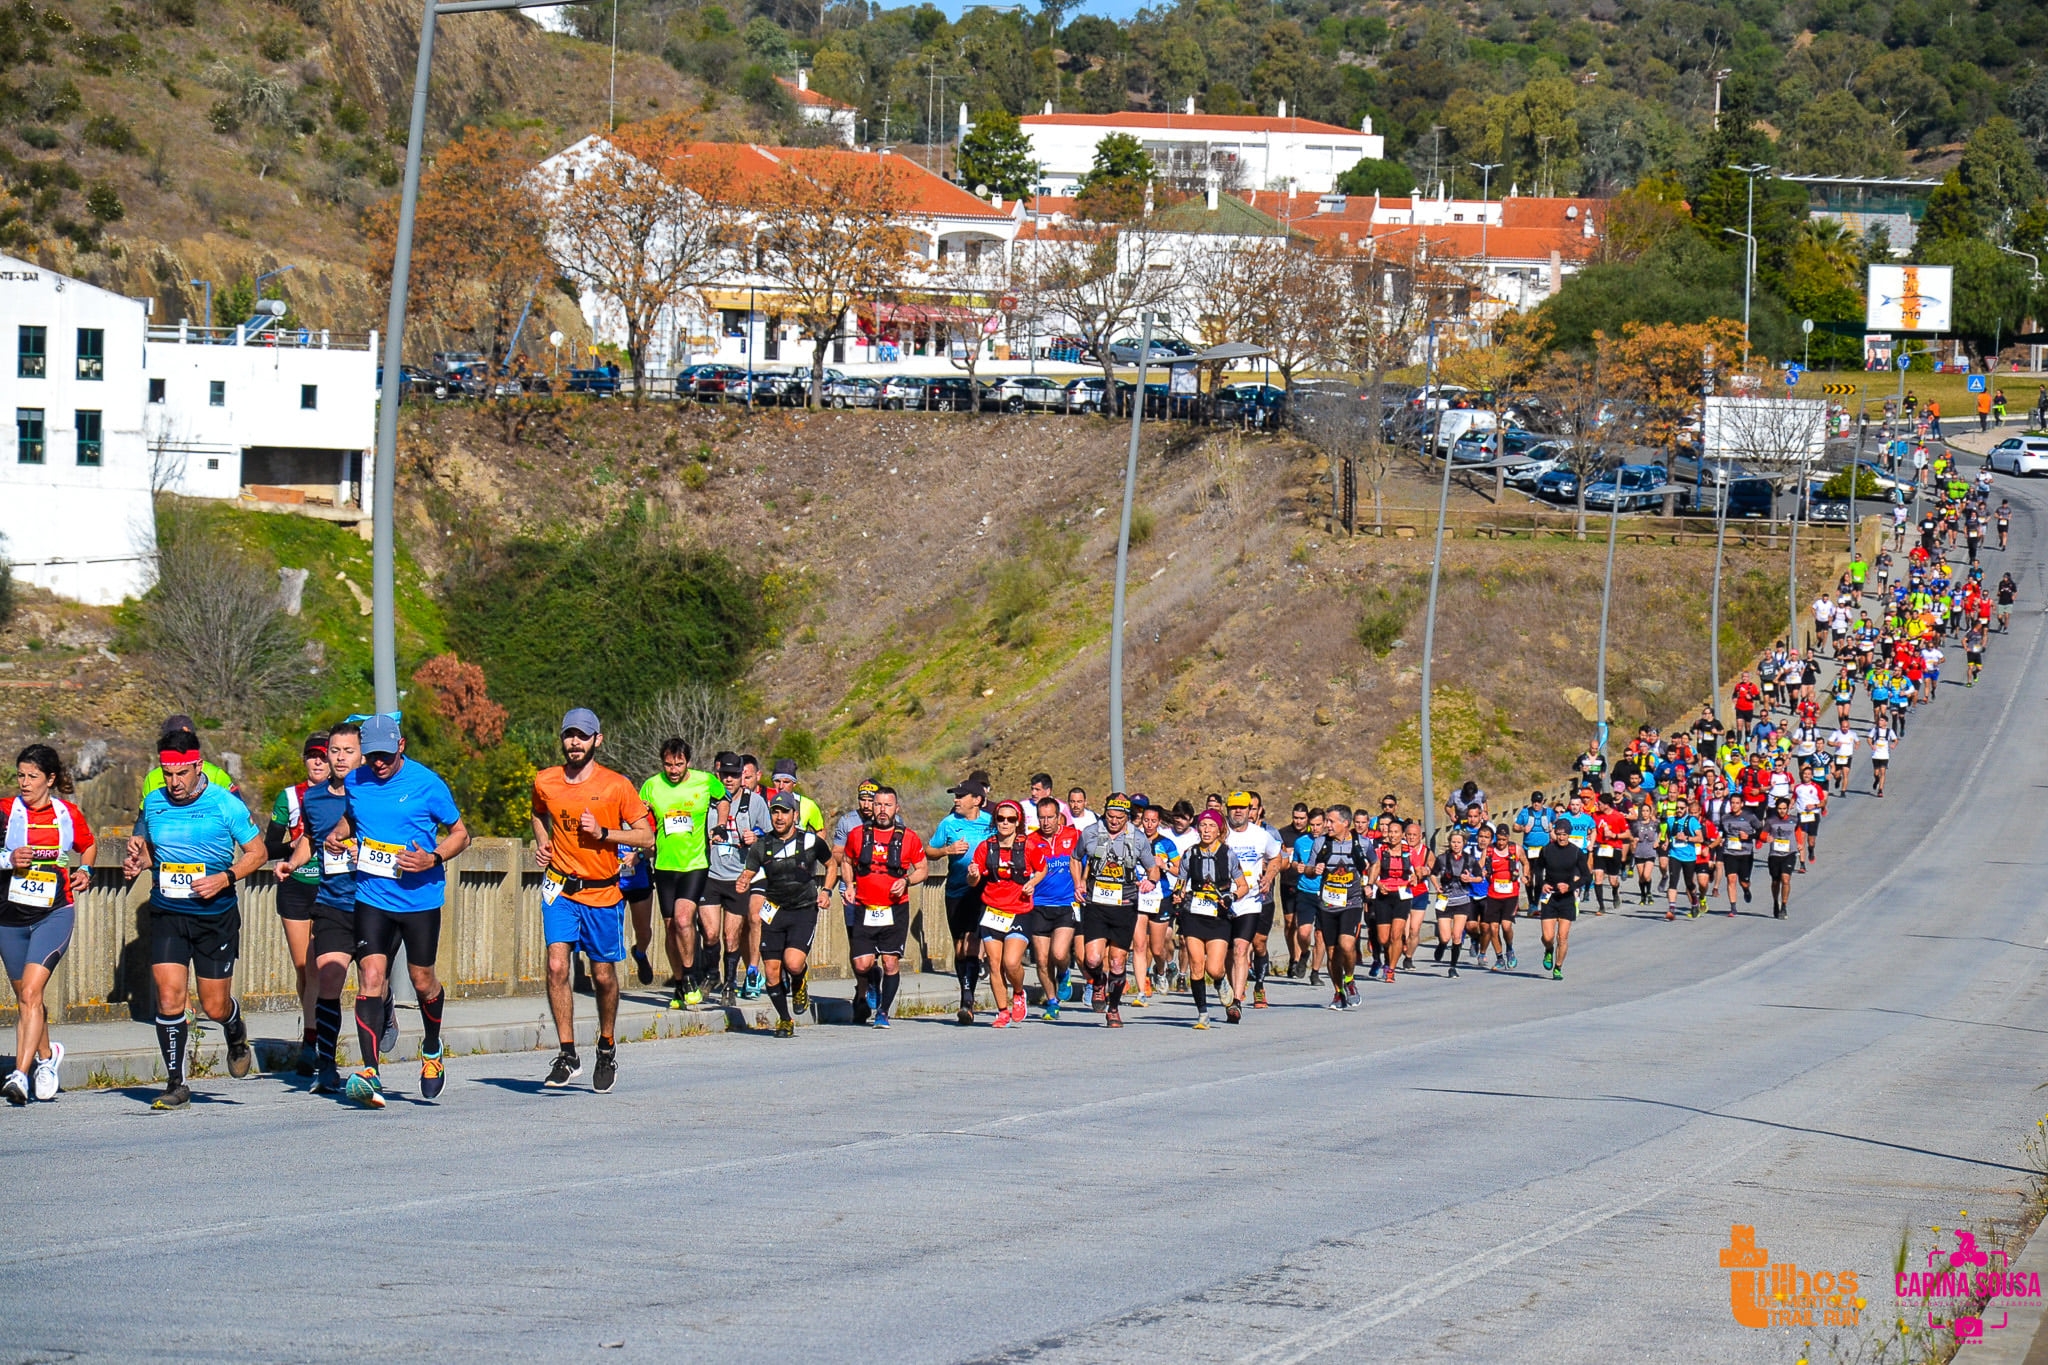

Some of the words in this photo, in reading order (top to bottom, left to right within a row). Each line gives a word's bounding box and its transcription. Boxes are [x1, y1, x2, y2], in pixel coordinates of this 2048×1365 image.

[672, 816, 688, 825] 540
[369, 850, 392, 864] 593
[170, 873, 193, 885] 430
[20, 880, 45, 893] 434
[1100, 888, 1115, 897] 367
[166, 1026, 180, 1070] Kalenji
